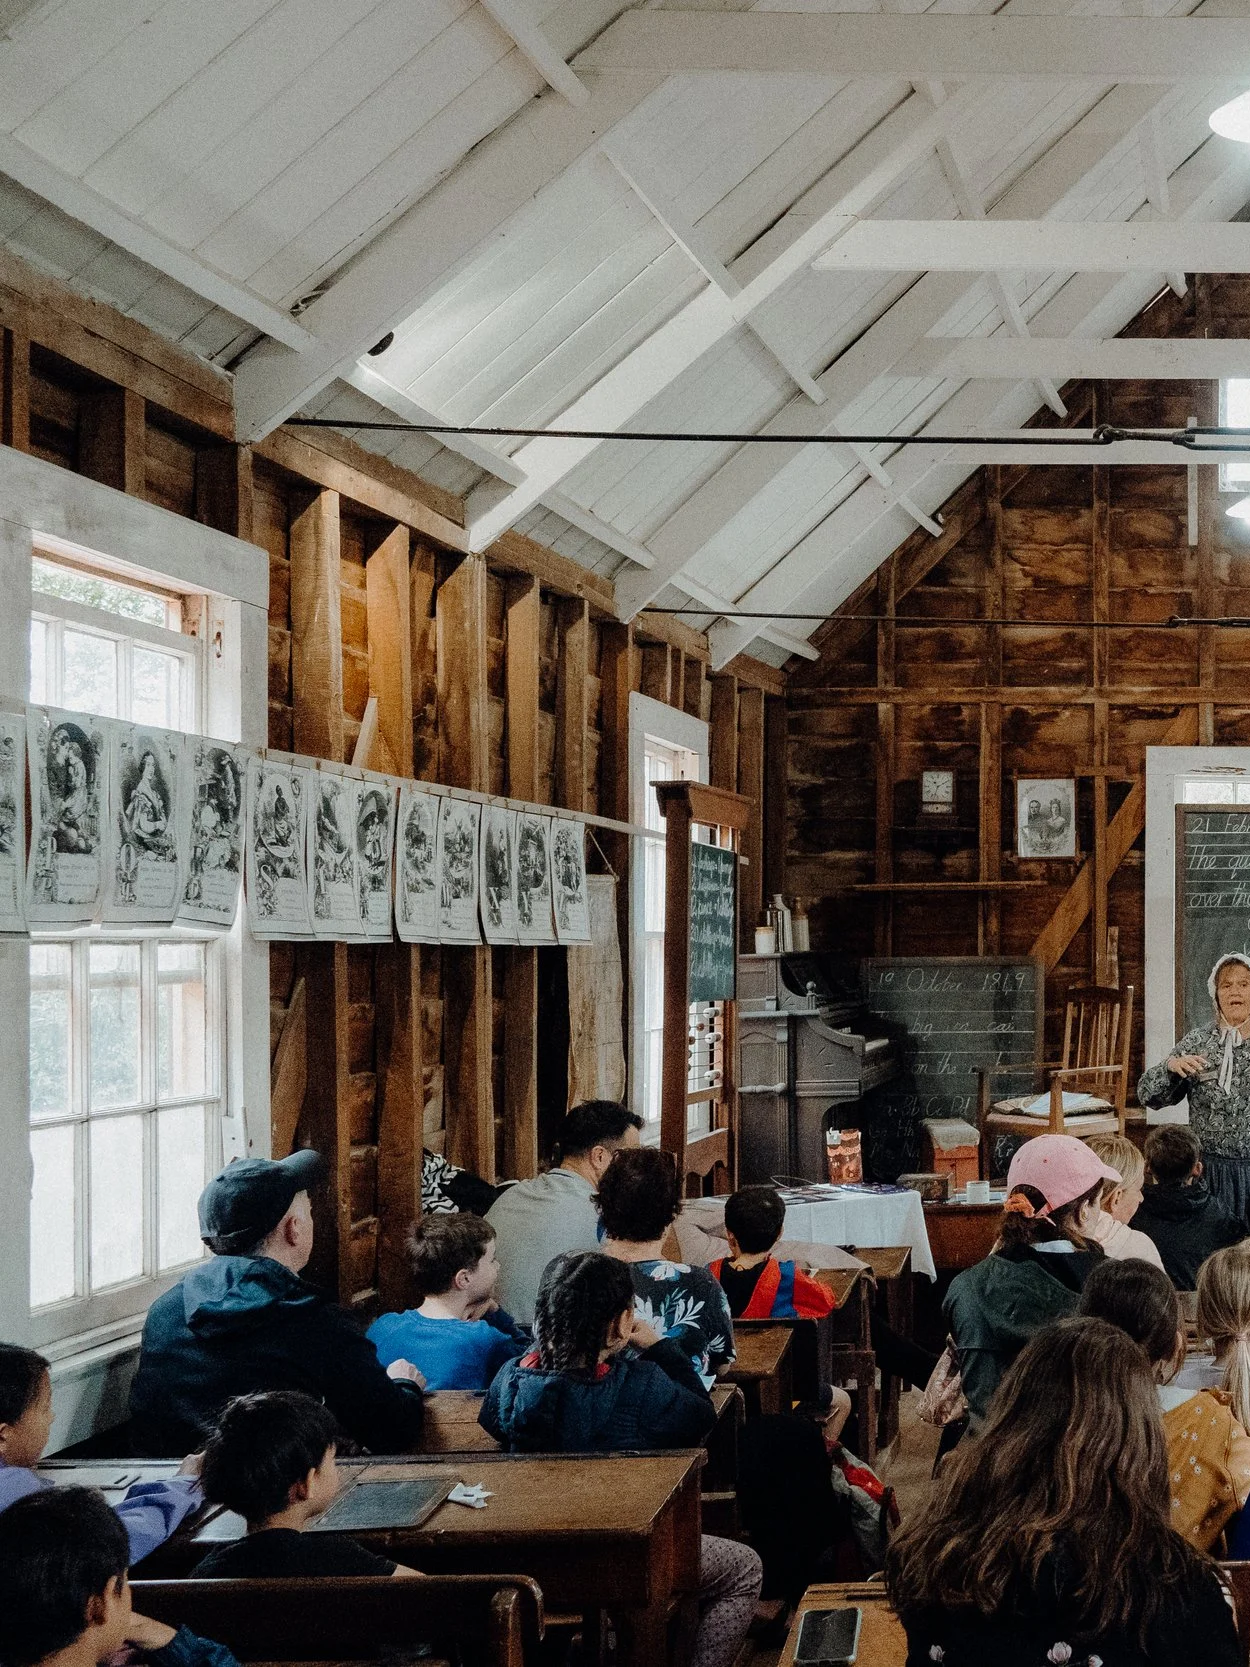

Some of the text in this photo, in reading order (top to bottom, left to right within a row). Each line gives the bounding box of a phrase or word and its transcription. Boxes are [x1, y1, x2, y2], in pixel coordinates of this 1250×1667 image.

[1191, 817, 1210, 833] 21
[1190, 844, 1217, 869] The
[1189, 892, 1228, 908] over
[907, 968, 963, 992] October
